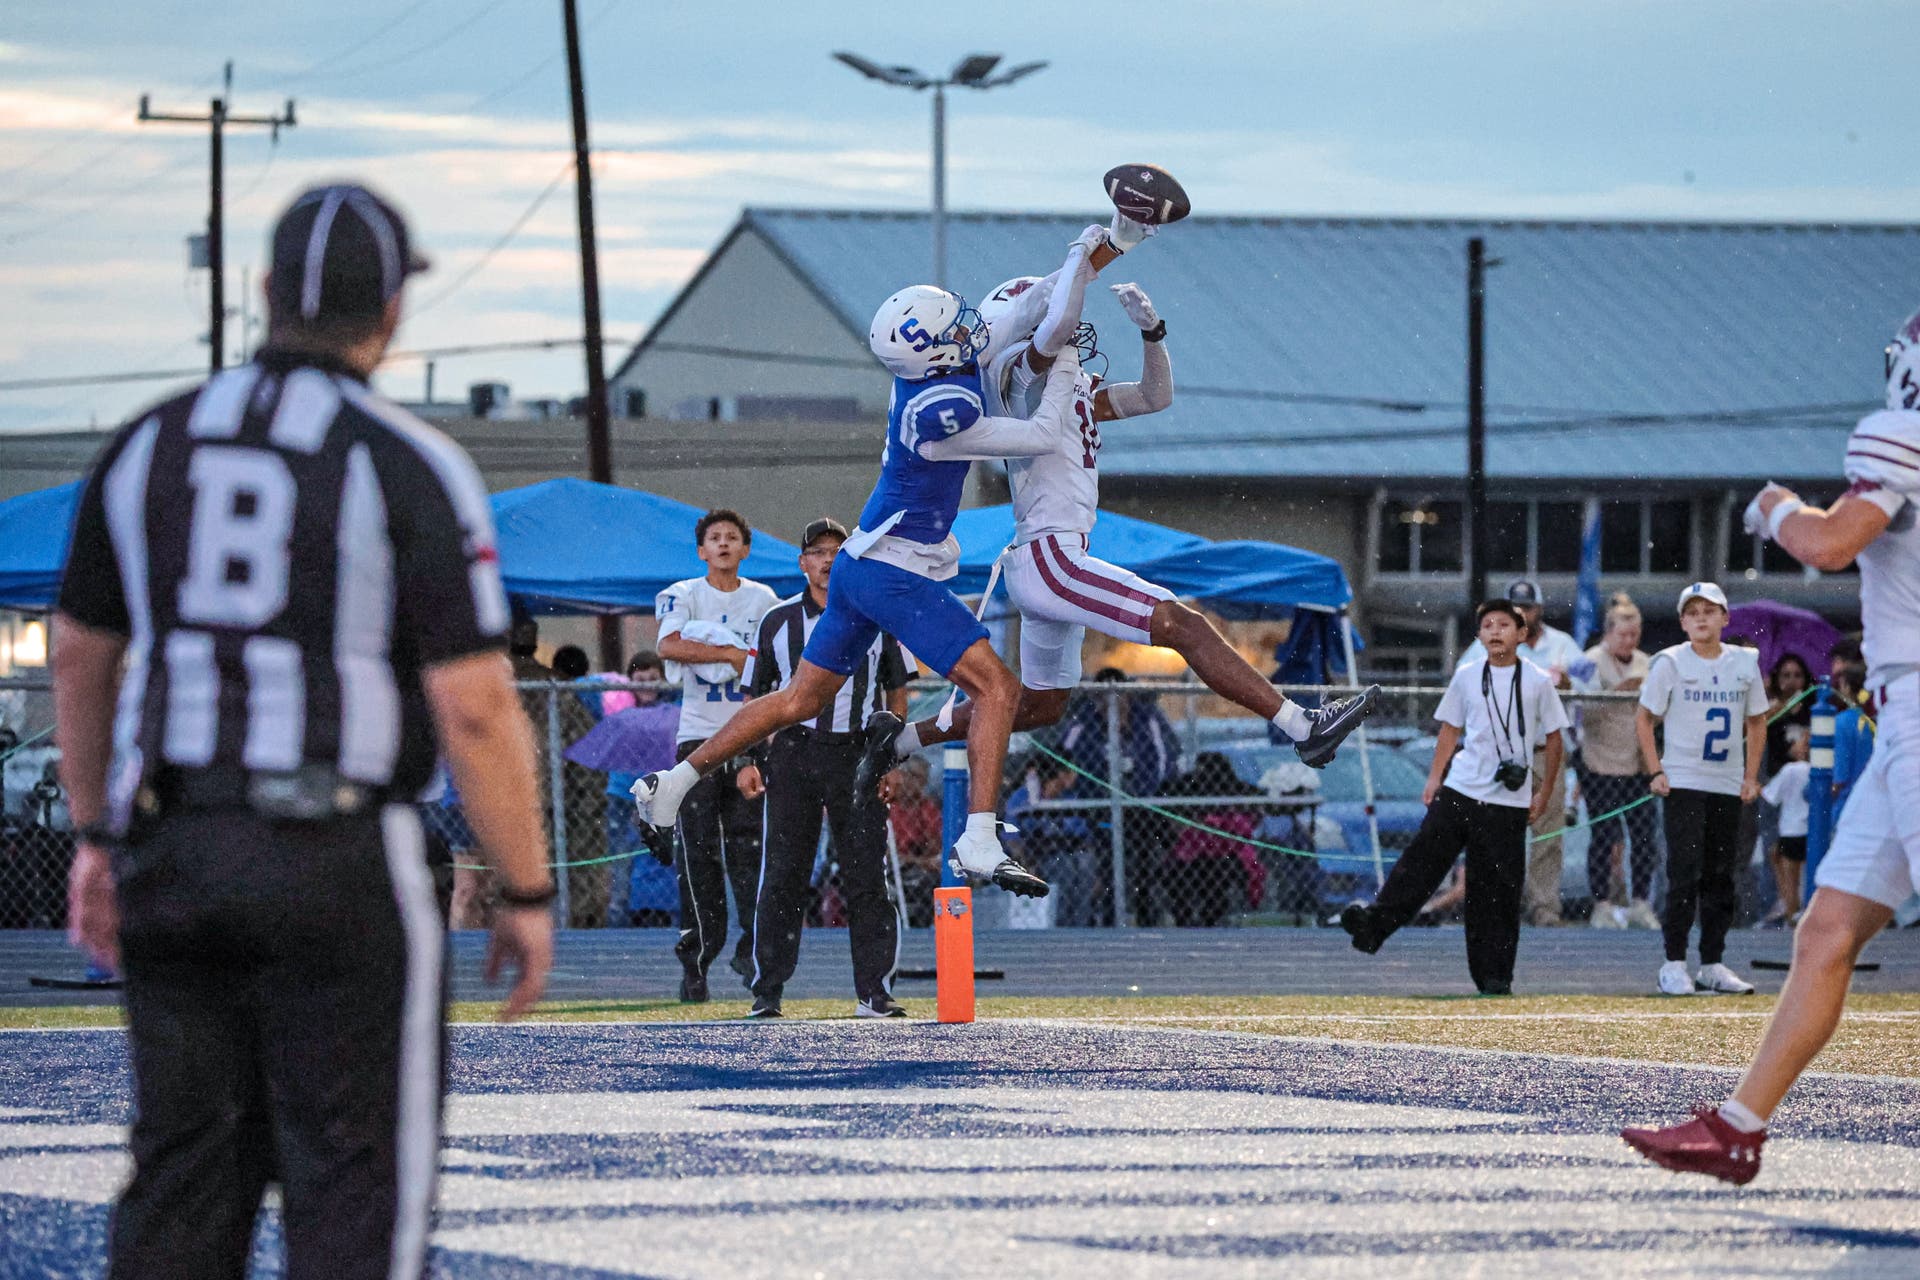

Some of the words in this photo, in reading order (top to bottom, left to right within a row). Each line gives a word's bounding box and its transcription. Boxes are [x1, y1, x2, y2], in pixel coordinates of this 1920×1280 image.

[899, 318, 933, 352] S
[938, 408, 960, 435] 5
[177, 444, 298, 629] B
[1703, 708, 1731, 762] 2
